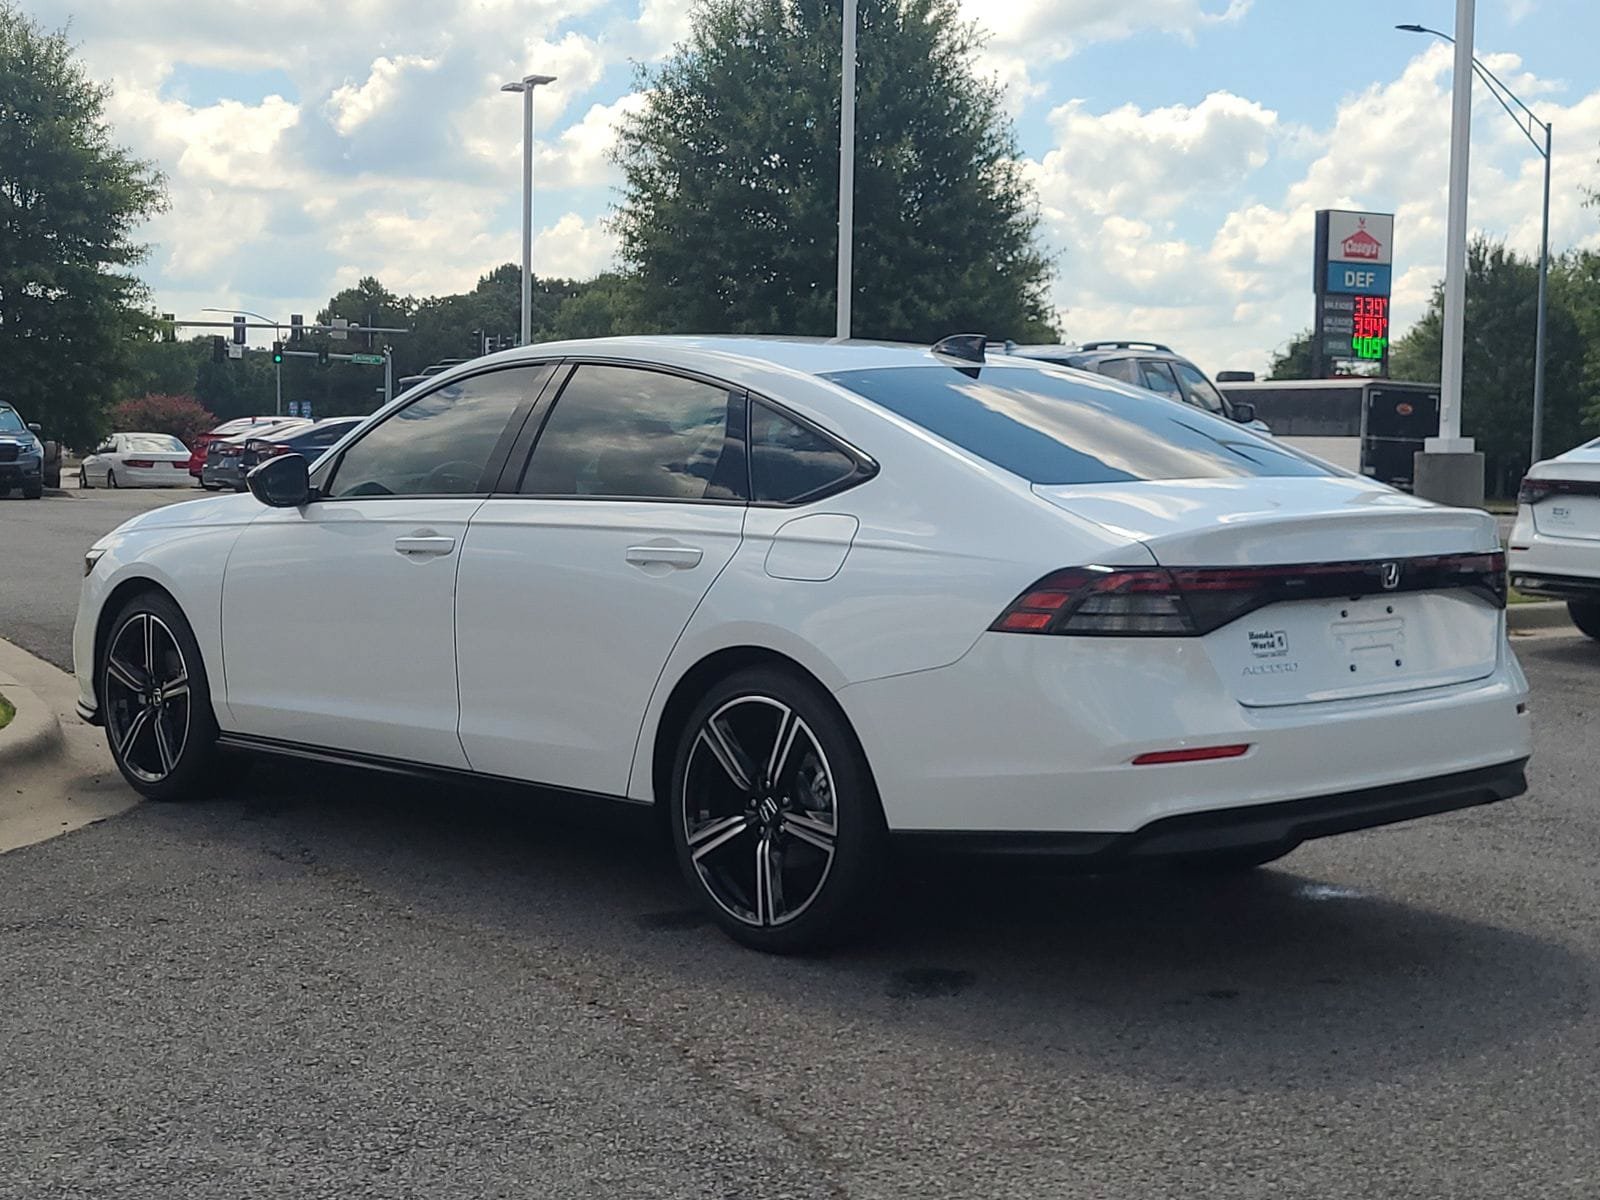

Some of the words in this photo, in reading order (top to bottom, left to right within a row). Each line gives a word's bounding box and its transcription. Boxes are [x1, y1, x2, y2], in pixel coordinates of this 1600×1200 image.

[1344, 271, 1376, 288] DEF
[1248, 630, 1274, 640] Honda
[1251, 640, 1275, 649] World
